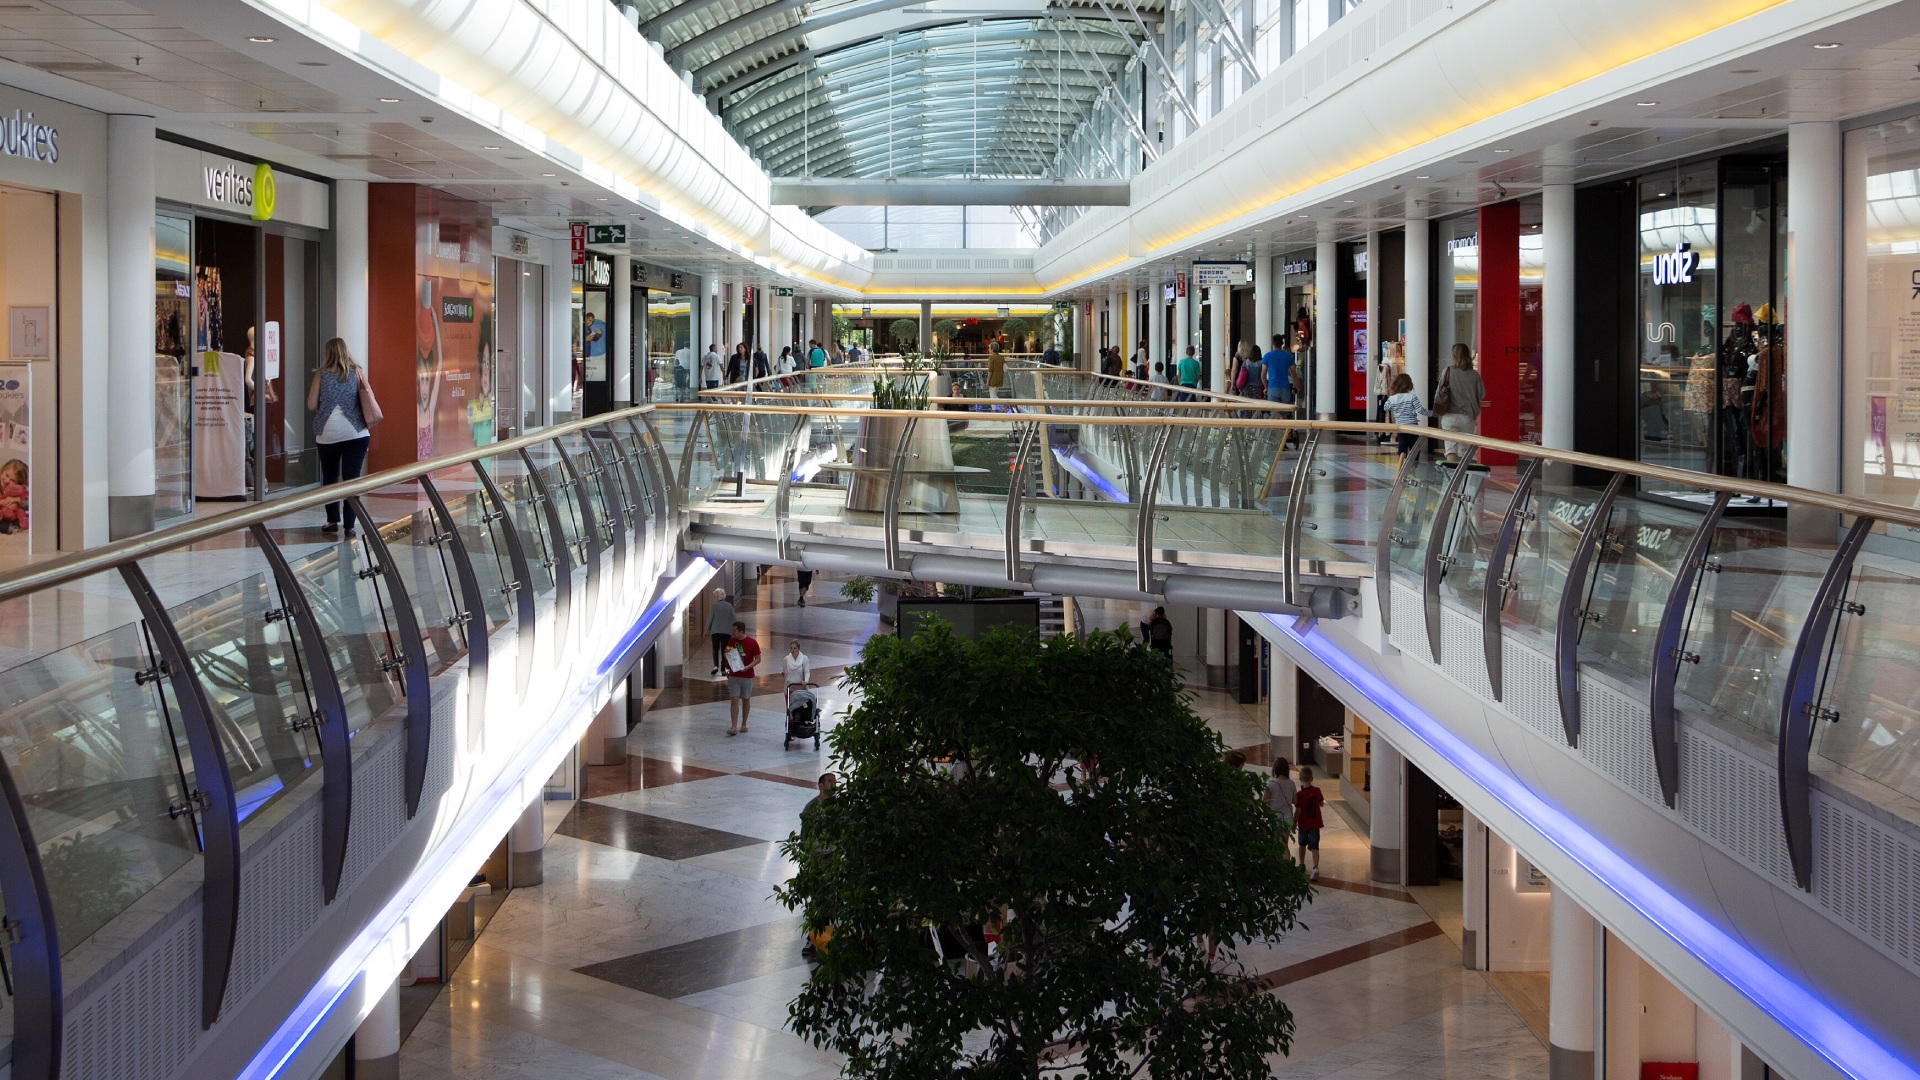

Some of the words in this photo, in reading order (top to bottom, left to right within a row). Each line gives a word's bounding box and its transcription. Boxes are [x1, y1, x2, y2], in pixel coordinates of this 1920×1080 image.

[205, 164, 253, 207] veritas
[1447, 231, 1478, 257] promod
[1653, 243, 1693, 286] undiz
